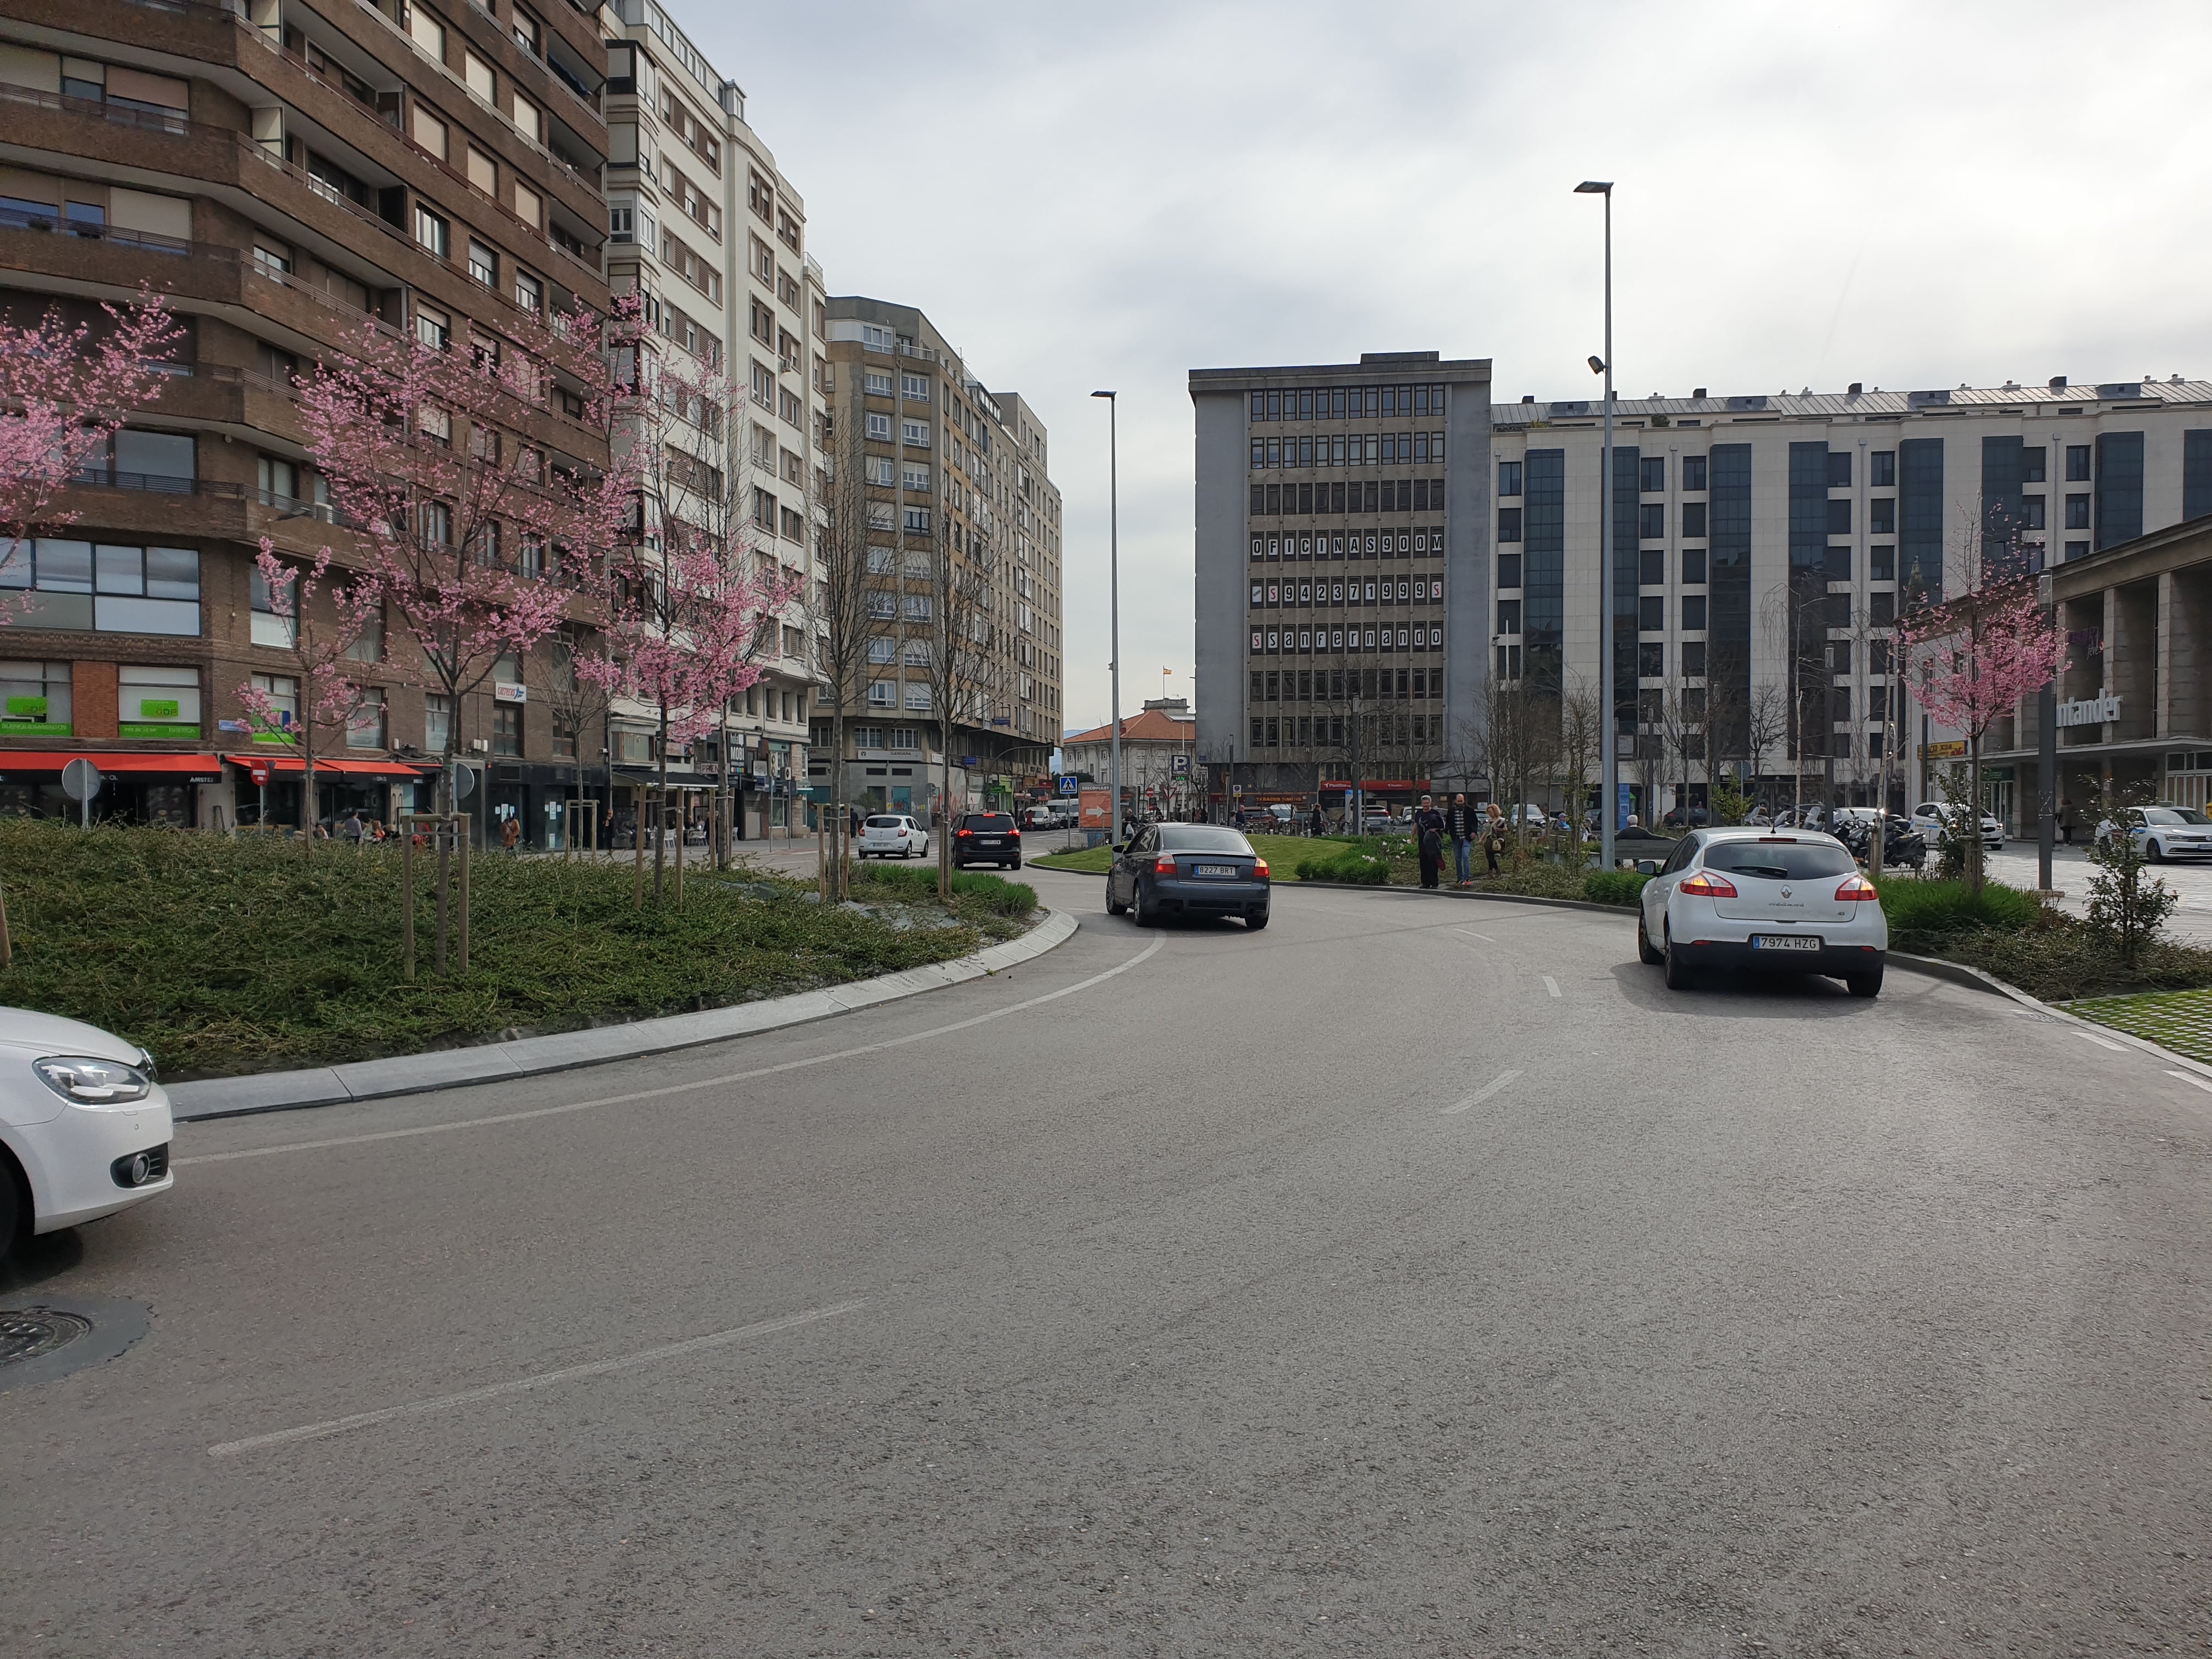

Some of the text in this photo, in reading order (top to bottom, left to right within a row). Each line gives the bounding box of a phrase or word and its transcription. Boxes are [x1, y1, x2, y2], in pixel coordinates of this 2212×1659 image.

[1286, 584, 1423, 600] 942371999
[2056, 688, 2123, 727] ntander
[730, 747, 744, 760] MOBI
[1174, 756, 1187, 771] P
[1761, 937, 1816, 949] 7974 HZG
